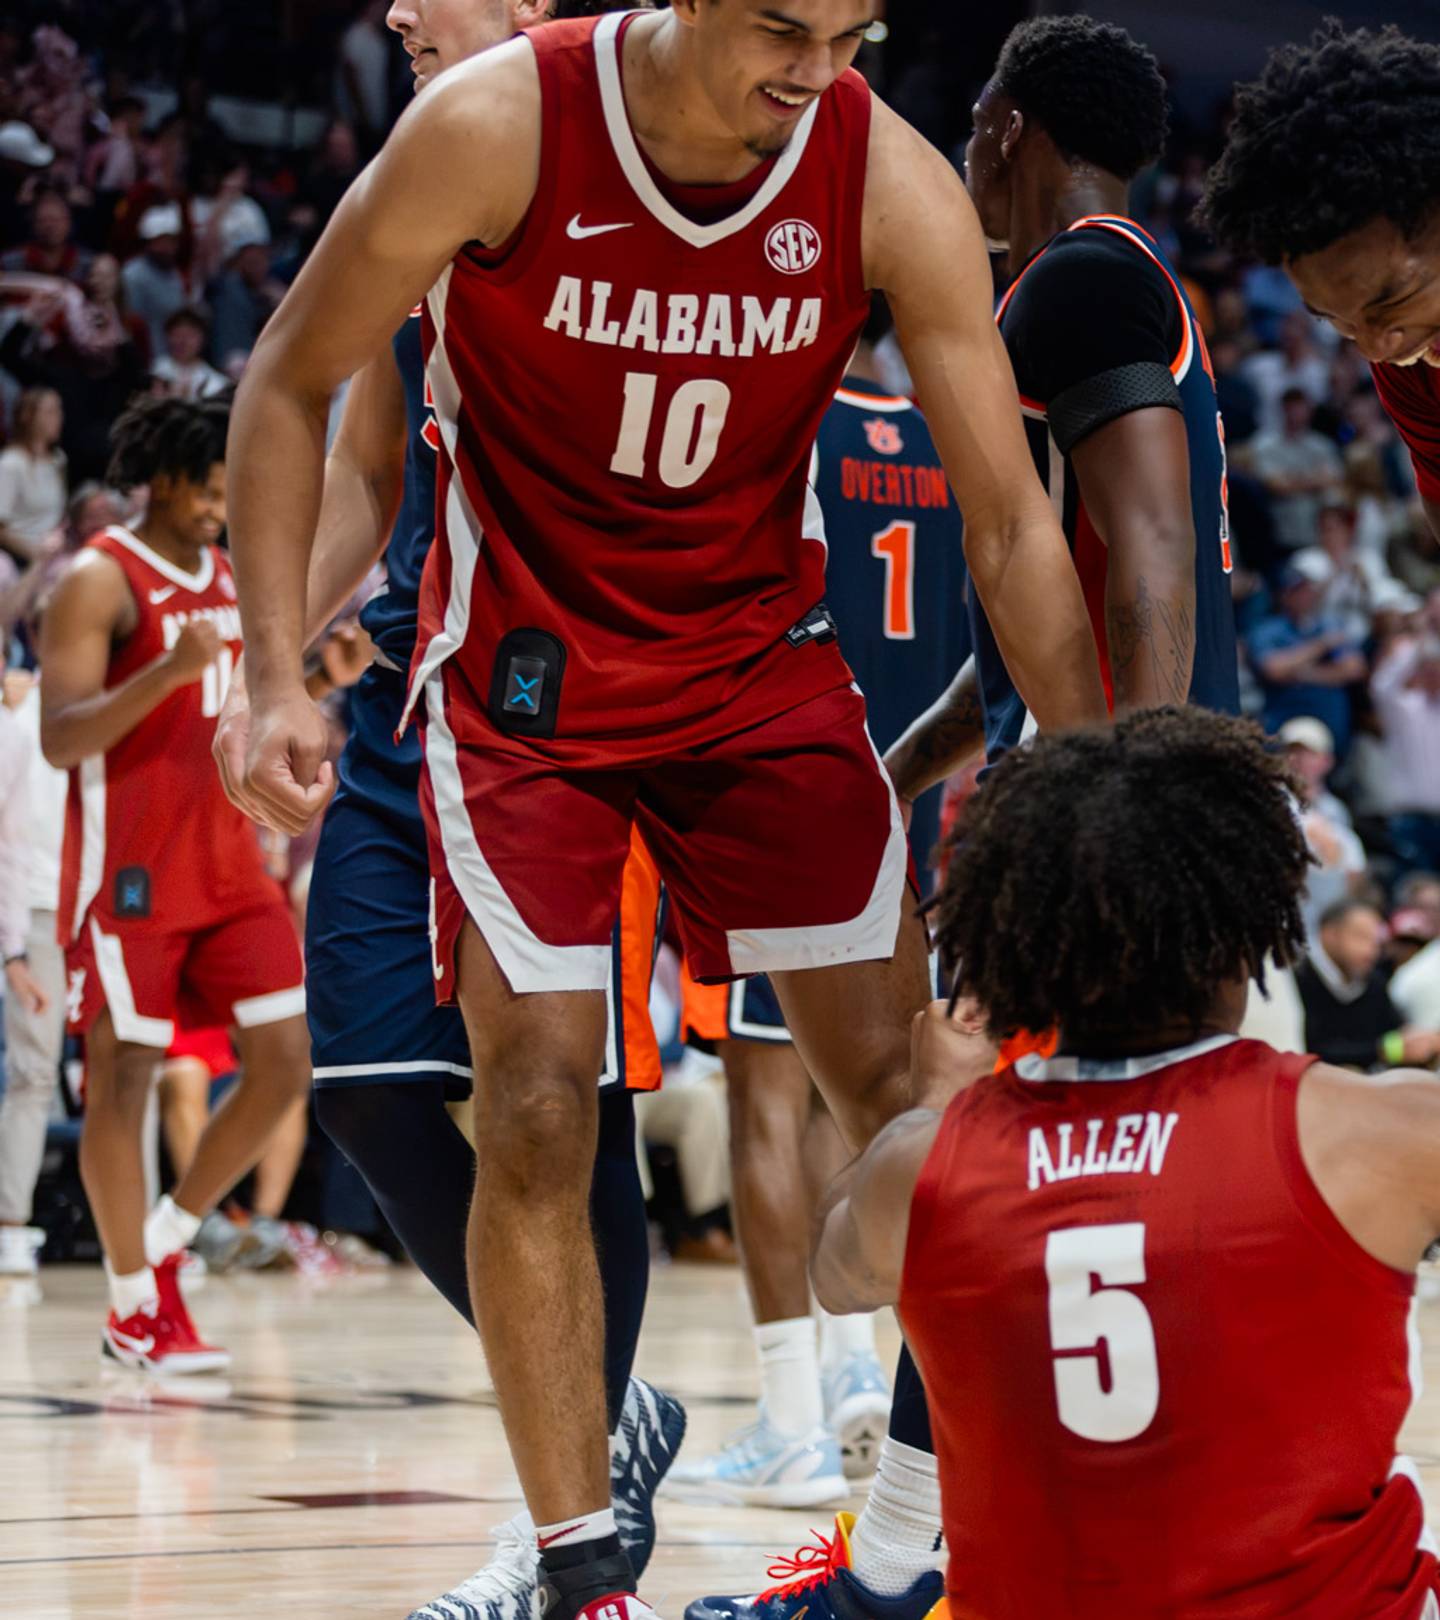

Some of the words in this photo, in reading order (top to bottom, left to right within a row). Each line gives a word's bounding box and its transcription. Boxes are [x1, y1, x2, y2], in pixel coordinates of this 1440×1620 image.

[769, 222, 817, 271] SEC
[543, 275, 822, 357] ALABAMA
[609, 372, 732, 488] 10
[841, 456, 949, 508] OVERTON
[871, 519, 916, 640] 1
[1027, 1111, 1179, 1191] ALLEN
[1045, 1222, 1160, 1443] 5
